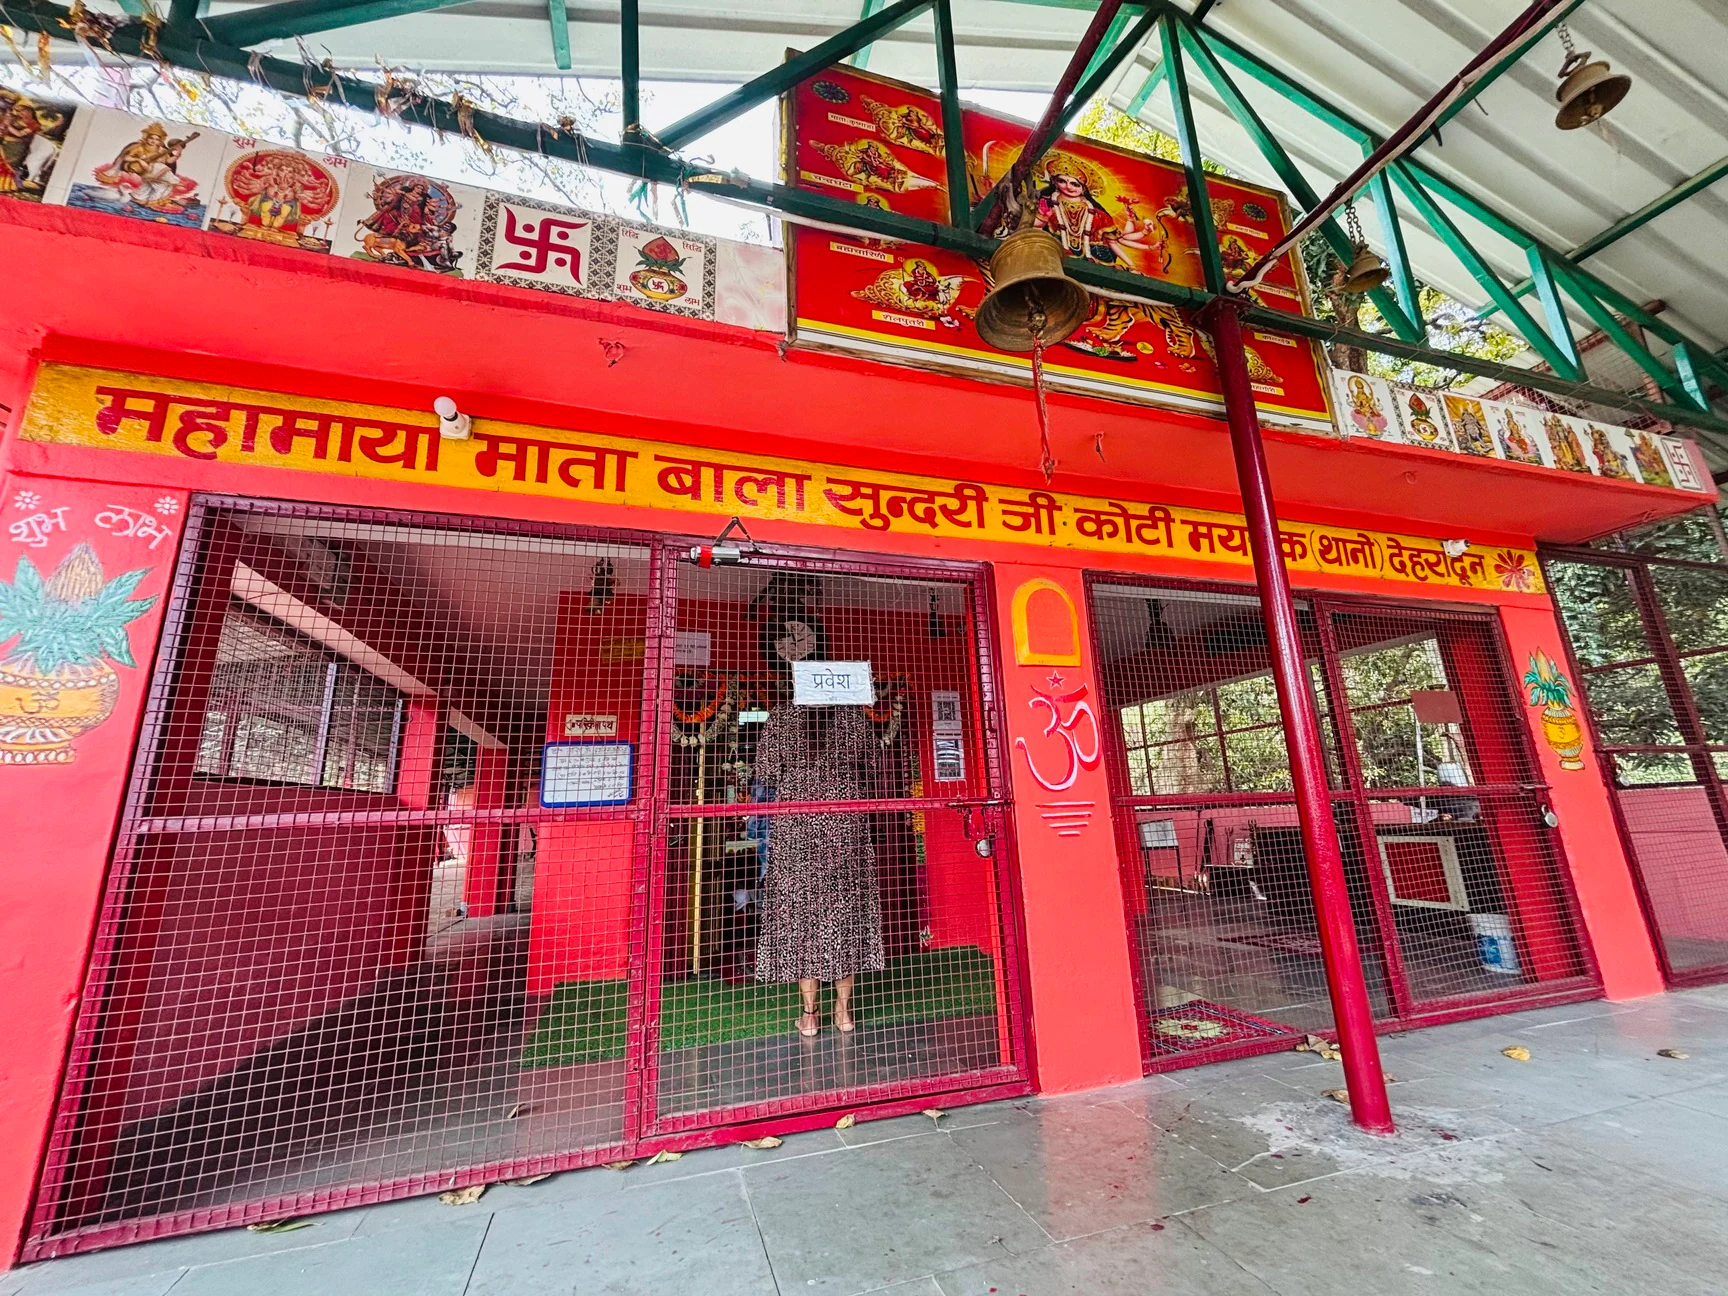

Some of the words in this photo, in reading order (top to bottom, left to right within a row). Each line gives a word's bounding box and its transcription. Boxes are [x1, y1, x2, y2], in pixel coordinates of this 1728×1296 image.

[233, 135, 256, 149] शुभ
[322, 155, 348, 168] लाभ
[684, 297, 701, 306] लाभ
[95, 386, 440, 472] महामाया
[474, 433, 639, 493] माता
[654, 453, 811, 512] बाला
[822, 483, 989, 532] सुन्दरी
[998, 491, 1062, 536] जी
[1073, 501, 1176, 549] कोटी
[1180, 518, 1307, 562] मयक
[1310, 530, 1384, 573] (थानो)
[1386, 536, 1488, 587] देहरादून
[9, 506, 71, 548] शुभ
[94, 504, 173, 550] लाभ
[811, 668, 851, 689] प्रवेश
